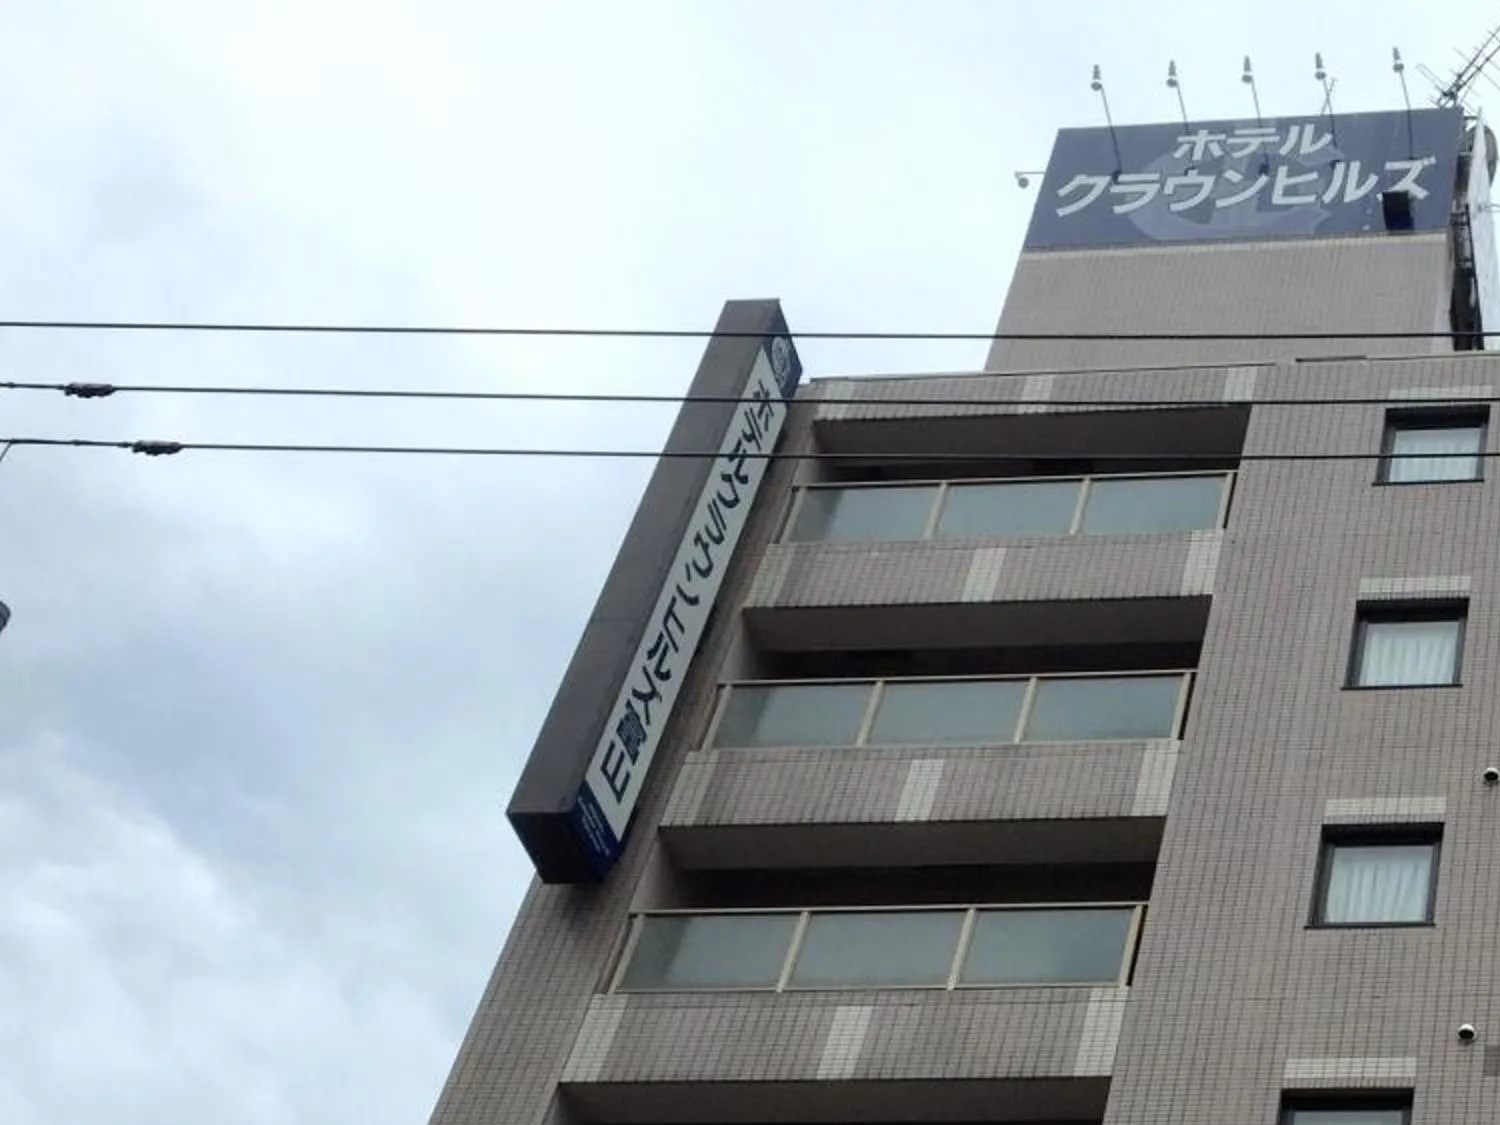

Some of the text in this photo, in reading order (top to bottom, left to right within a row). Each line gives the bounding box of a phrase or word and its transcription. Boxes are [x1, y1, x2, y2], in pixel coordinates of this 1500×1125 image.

[1173, 123, 1333, 161] ホテル
[1056, 156, 1436, 217] クラウンヒルズ
[600, 378, 775, 804] ホテルクラウンヒルズ富山
